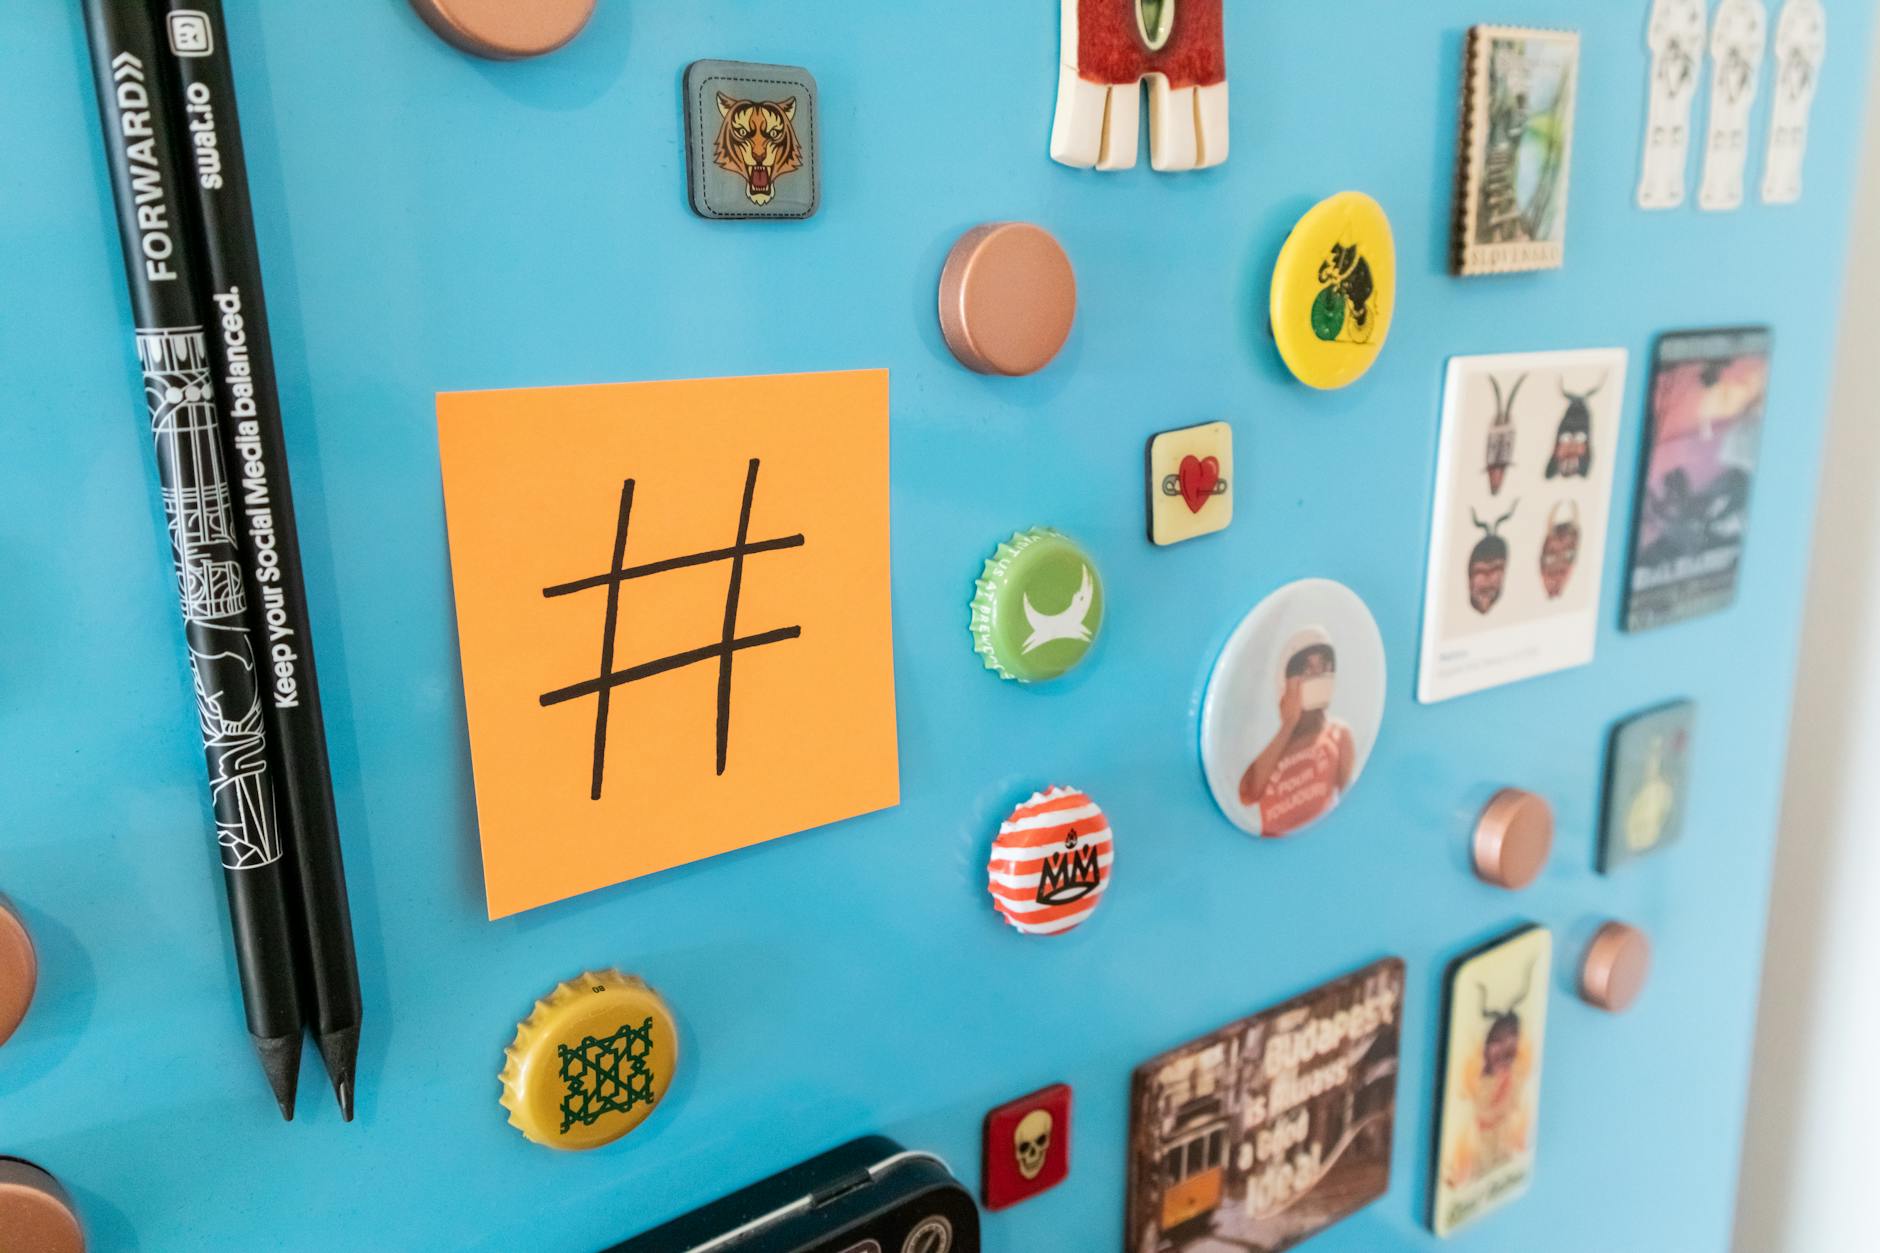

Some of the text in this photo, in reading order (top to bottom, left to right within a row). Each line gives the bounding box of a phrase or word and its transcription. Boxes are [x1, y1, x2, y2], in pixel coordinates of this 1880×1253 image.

[186, 82, 223, 190] swat.io
[212, 286, 299, 708] Keep your Social Media balanced.
